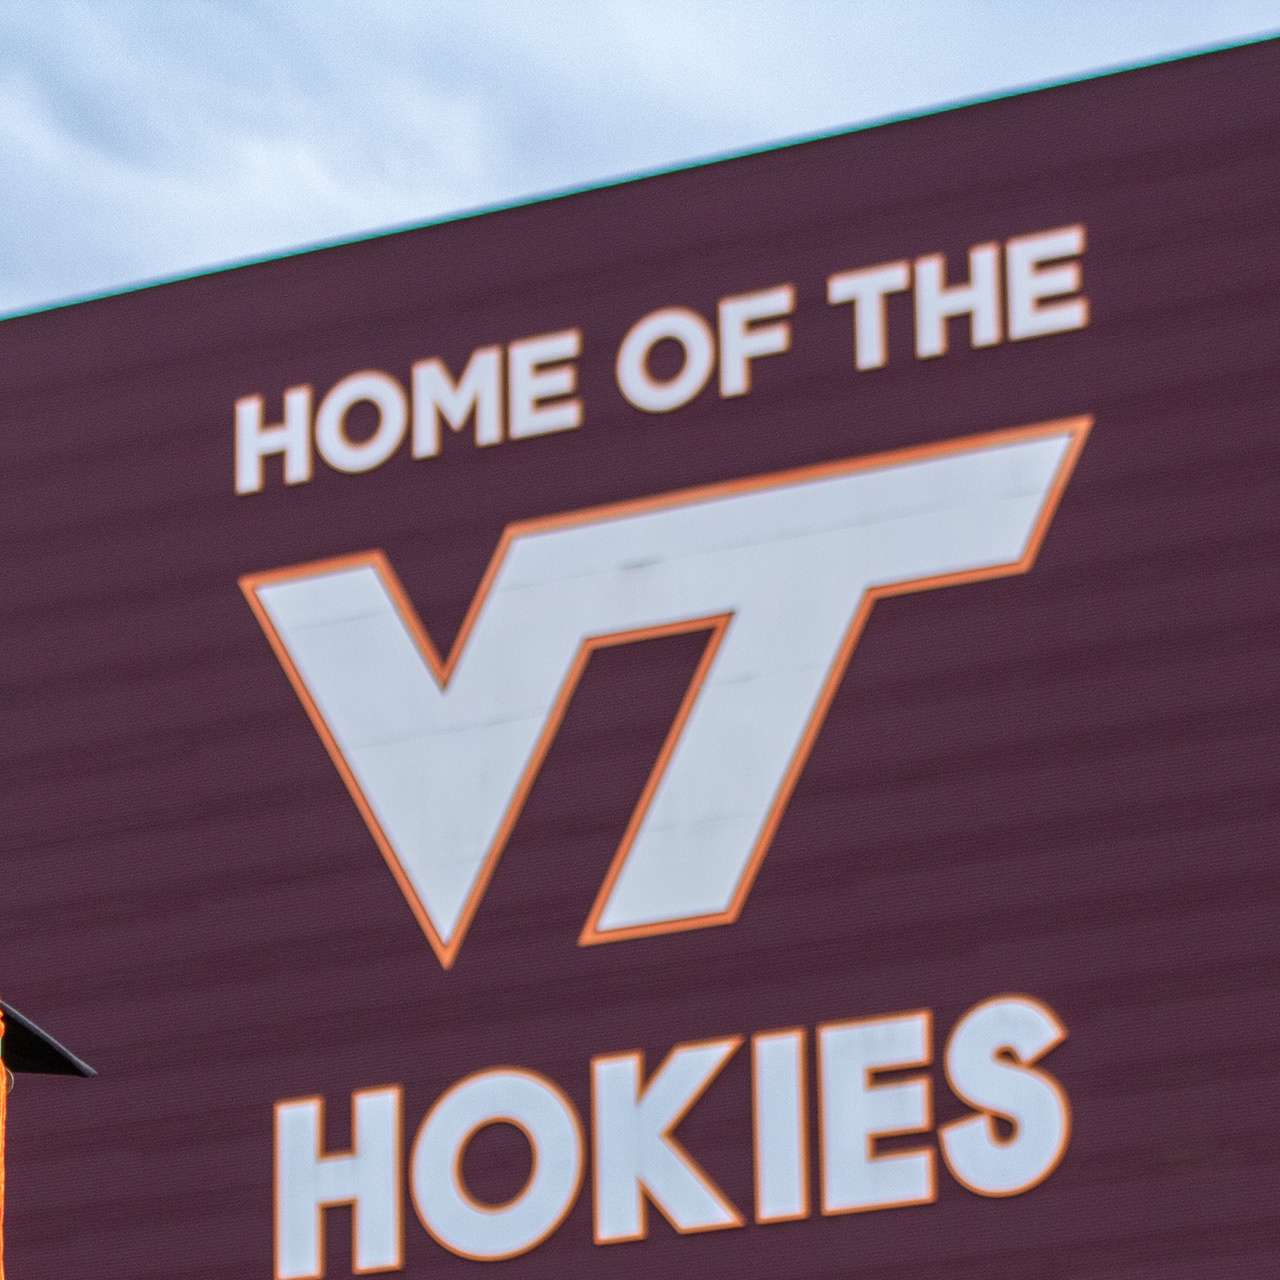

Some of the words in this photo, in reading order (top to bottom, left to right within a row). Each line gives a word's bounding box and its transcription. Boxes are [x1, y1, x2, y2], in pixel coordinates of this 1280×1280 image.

[234, 328, 583, 496] HOME
[615, 283, 796, 414] OF
[827, 224, 1089, 371] THE
[238, 415, 1094, 970] VT
